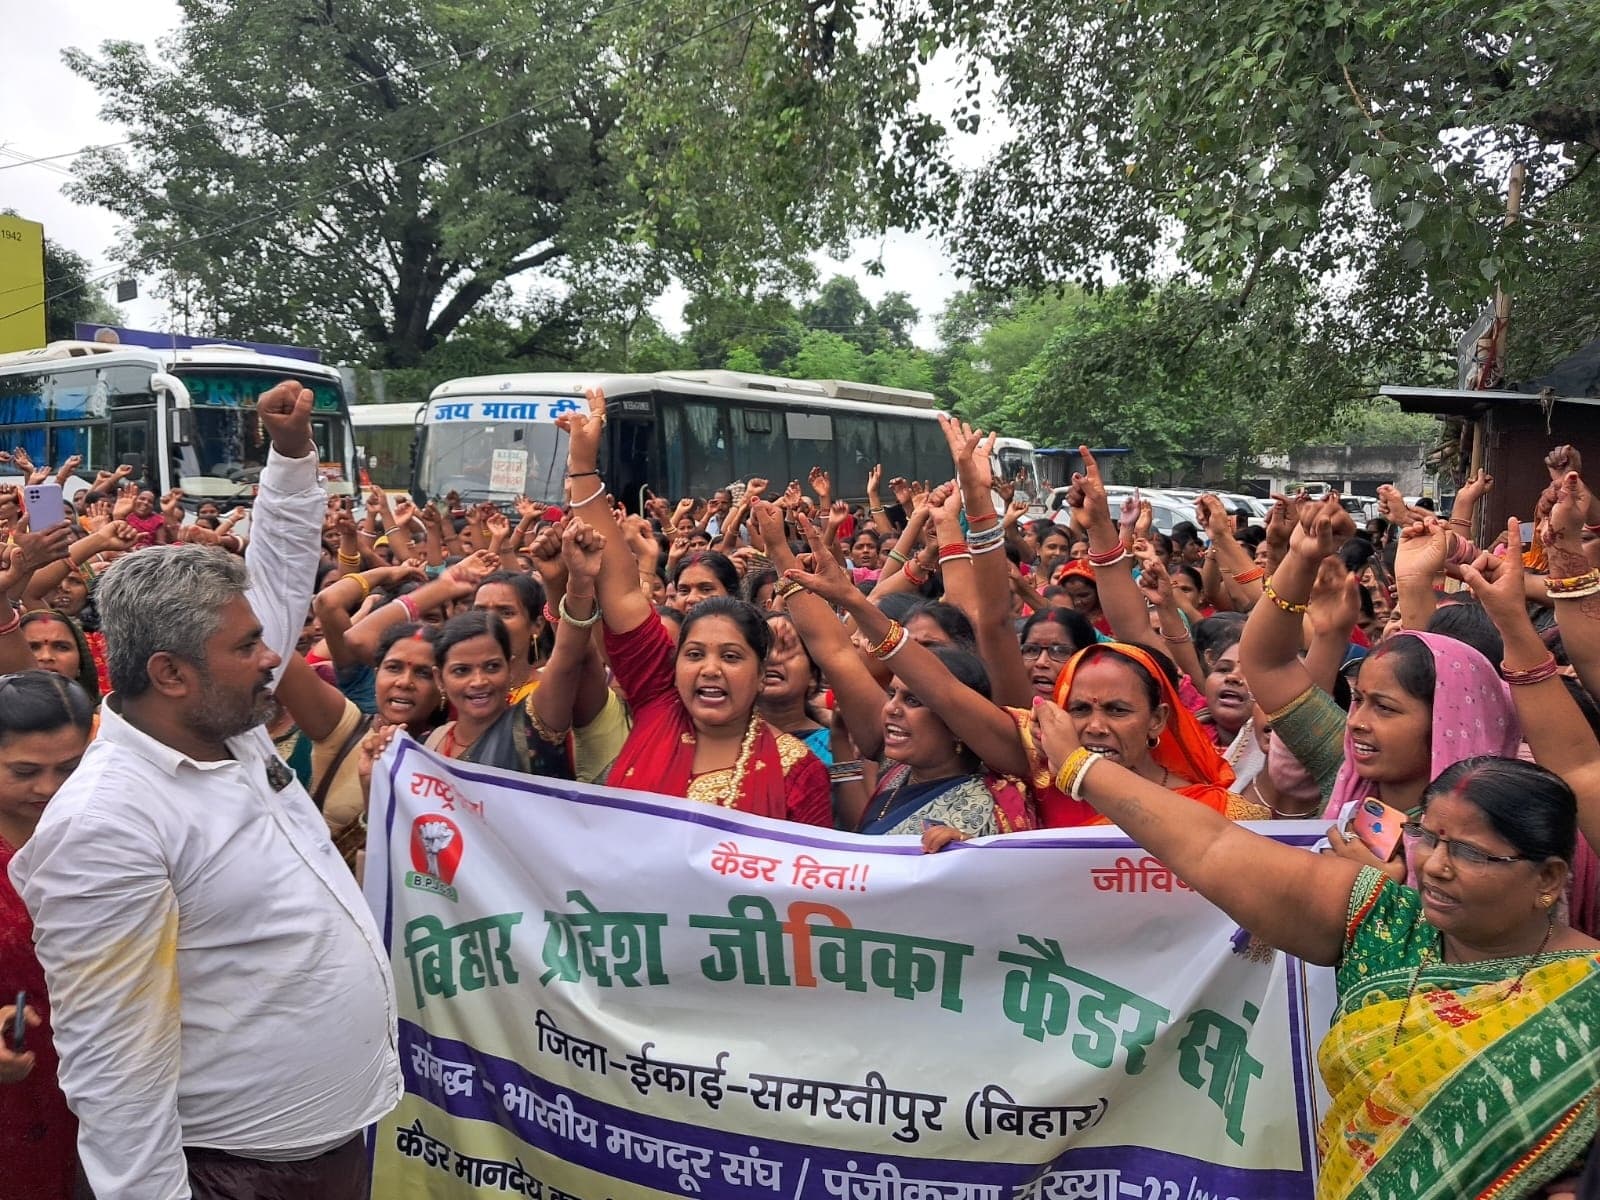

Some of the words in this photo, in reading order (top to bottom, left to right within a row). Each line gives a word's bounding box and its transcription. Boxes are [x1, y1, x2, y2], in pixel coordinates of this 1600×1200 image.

[434, 403, 473, 420] जय
[482, 402, 539, 420] माता
[711, 841, 782, 882] कैडर
[791, 855, 870, 891] हित!!
[404, 914, 524, 1009] बिहार
[539, 890, 669, 988] प्रदेश
[689, 894, 975, 1013] जीविका
[998, 934, 1171, 1076] कैडर
[411, 1042, 477, 1097] संबद्ध
[503, 1082, 599, 1148] भारतीय
[605, 1124, 714, 1193] मजदूर
[719, 1145, 784, 1192] संघ
[965, 1084, 1109, 1141] (बिहार)
[396, 1118, 451, 1171] कैडर
[454, 1157, 544, 1200] मानदेय
